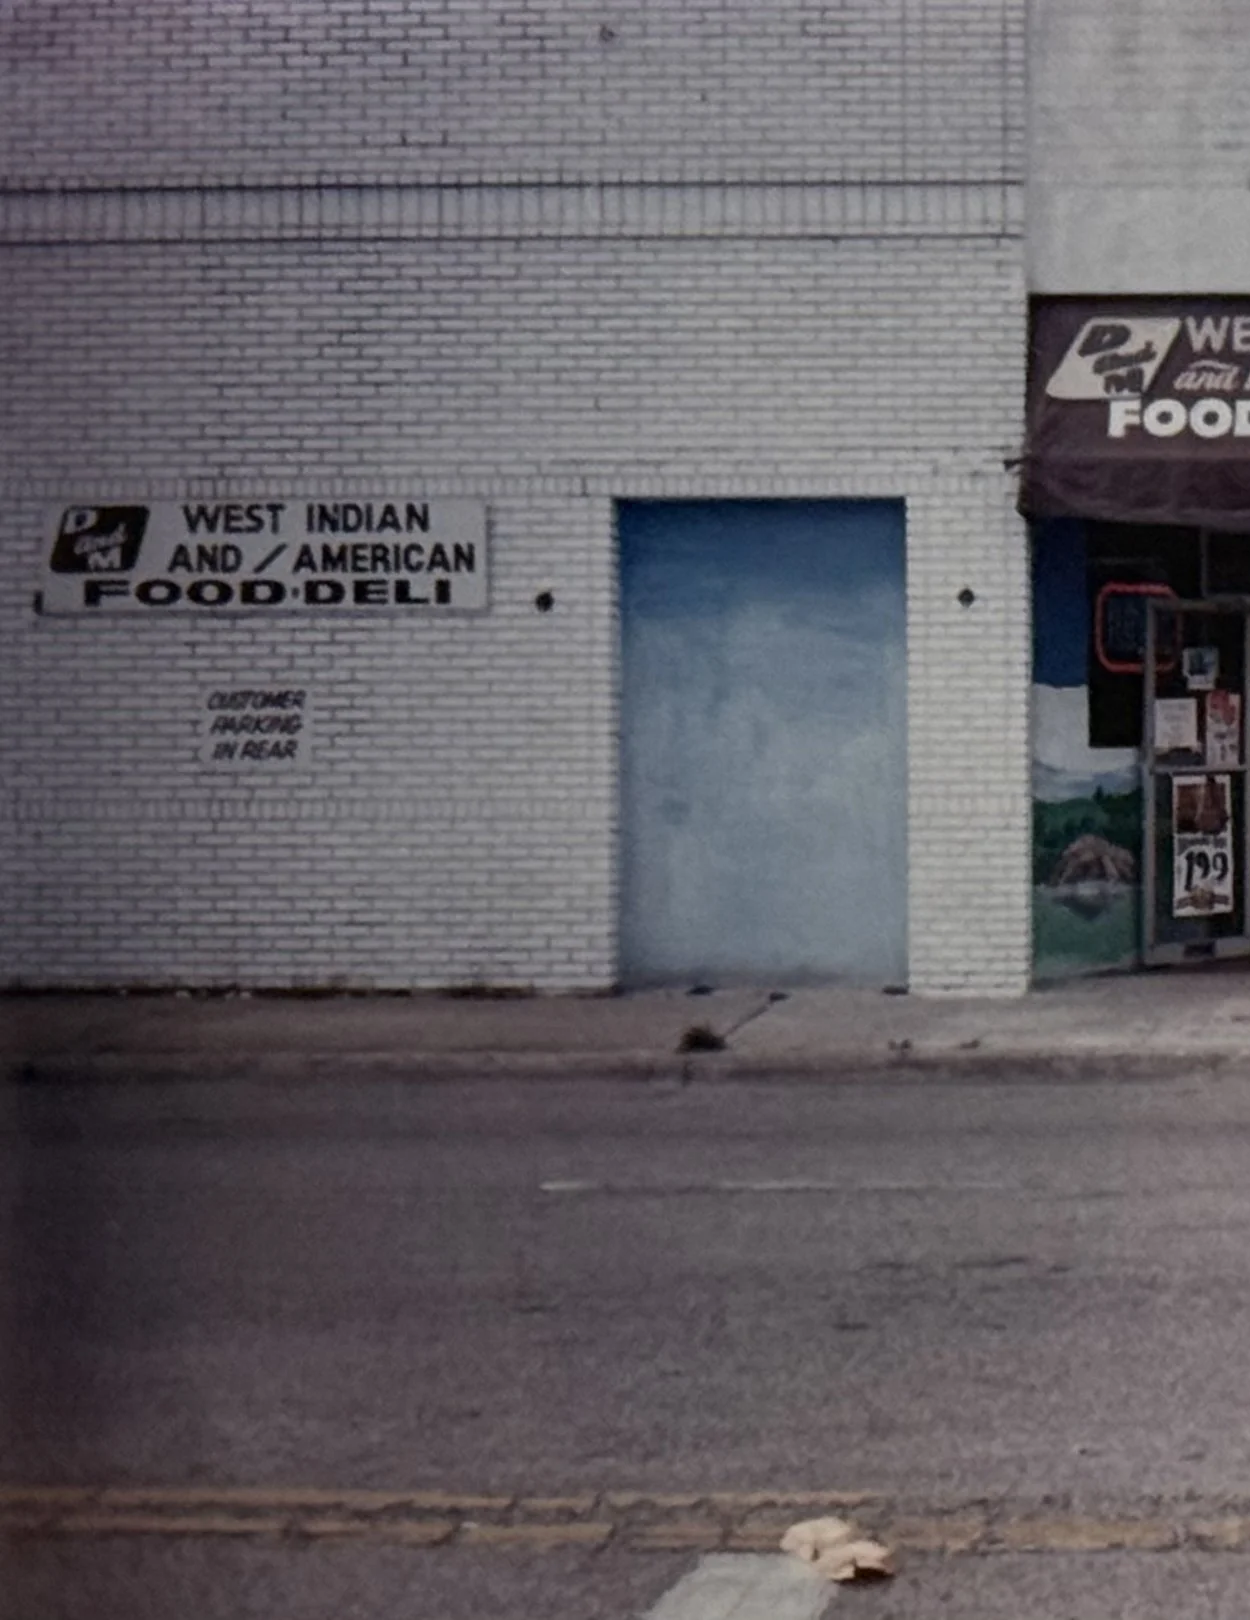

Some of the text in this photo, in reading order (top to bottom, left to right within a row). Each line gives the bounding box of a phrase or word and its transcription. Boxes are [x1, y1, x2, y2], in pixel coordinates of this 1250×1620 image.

[1173, 359, 1240, 391] and
[181, 503, 430, 534] WEST INDIAN
[207, 690, 307, 711] CUSTOMER
[210, 714, 304, 737] PARKING
[212, 739, 298, 760] IN REAR
[1184, 850, 1229, 892] 199
